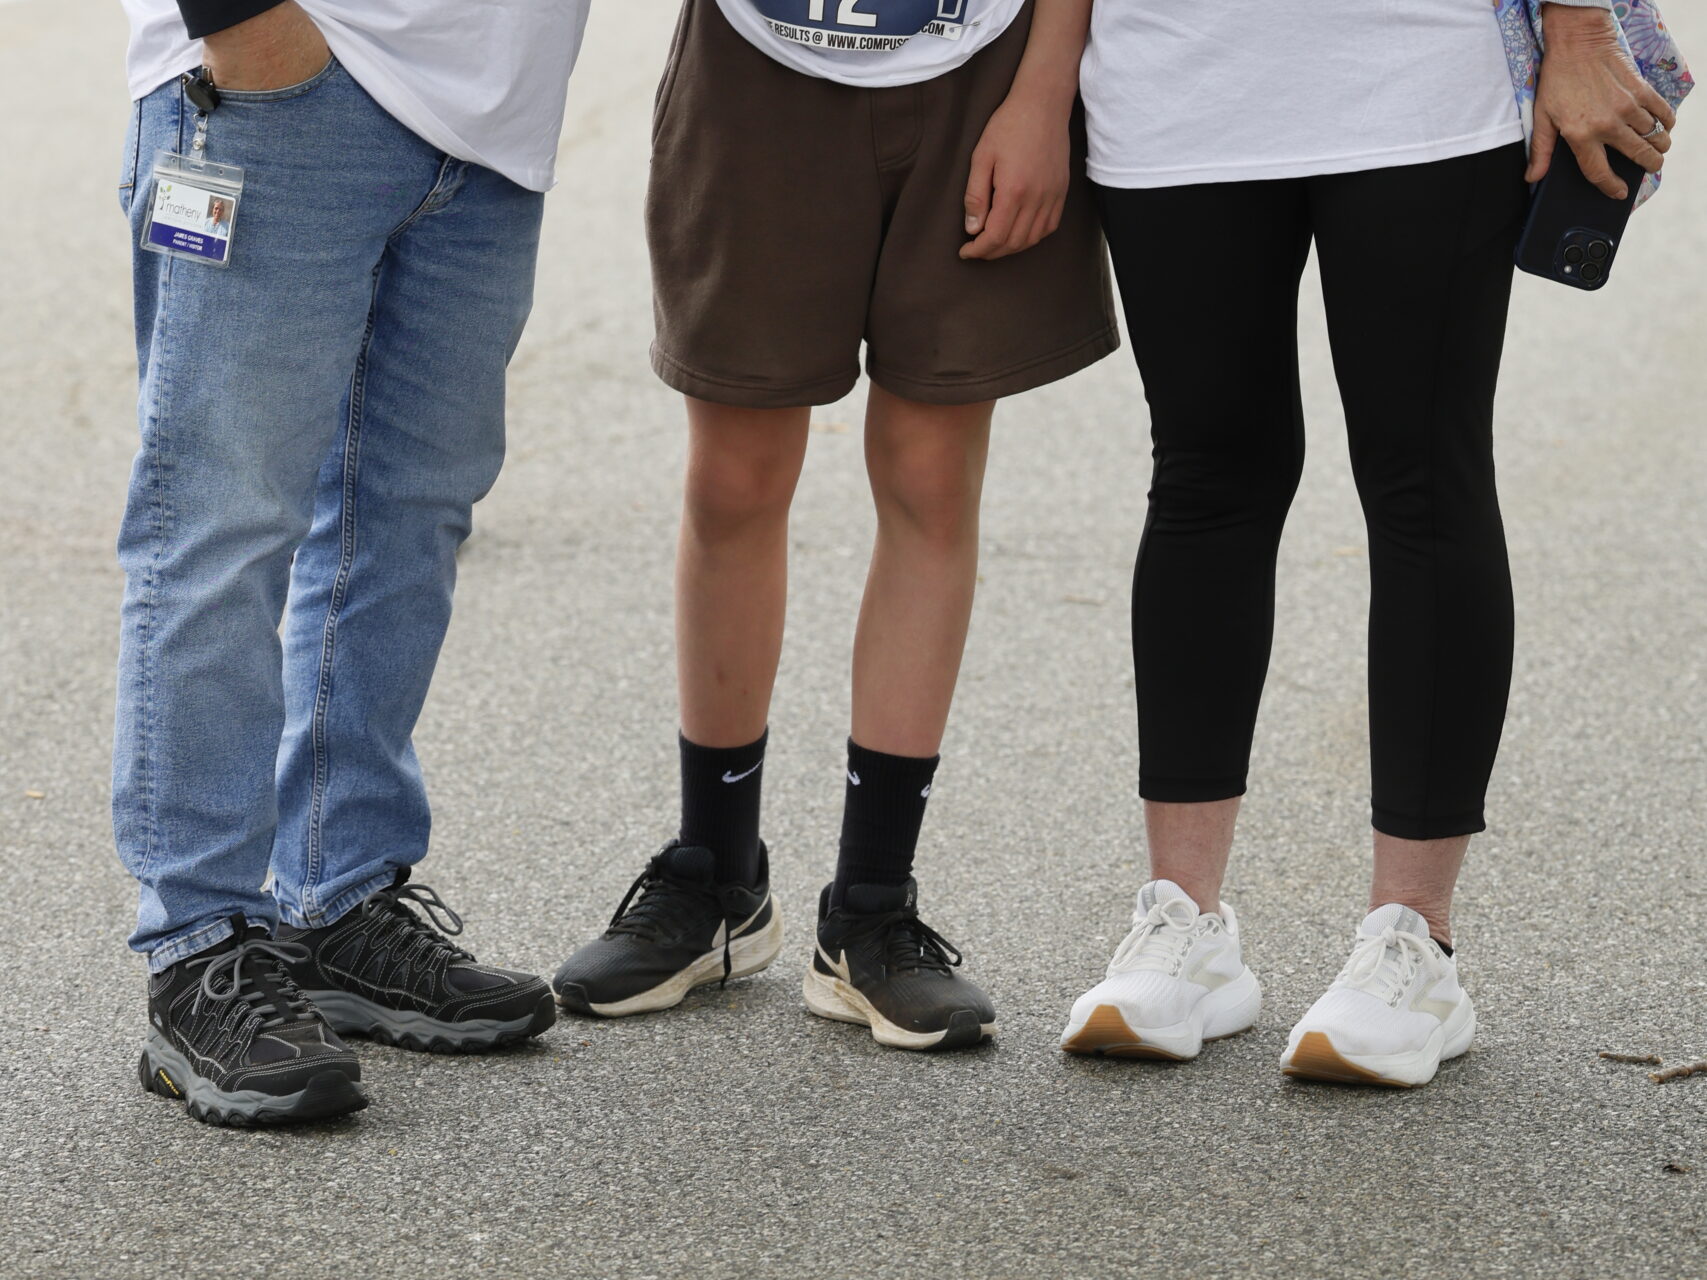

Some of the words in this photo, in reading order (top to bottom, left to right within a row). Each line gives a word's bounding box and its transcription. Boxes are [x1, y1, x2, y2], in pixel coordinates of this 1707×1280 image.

[775, 25, 810, 42] RESULTS
[812, 33, 823, 45] @
[166, 203, 201, 223] matheny
